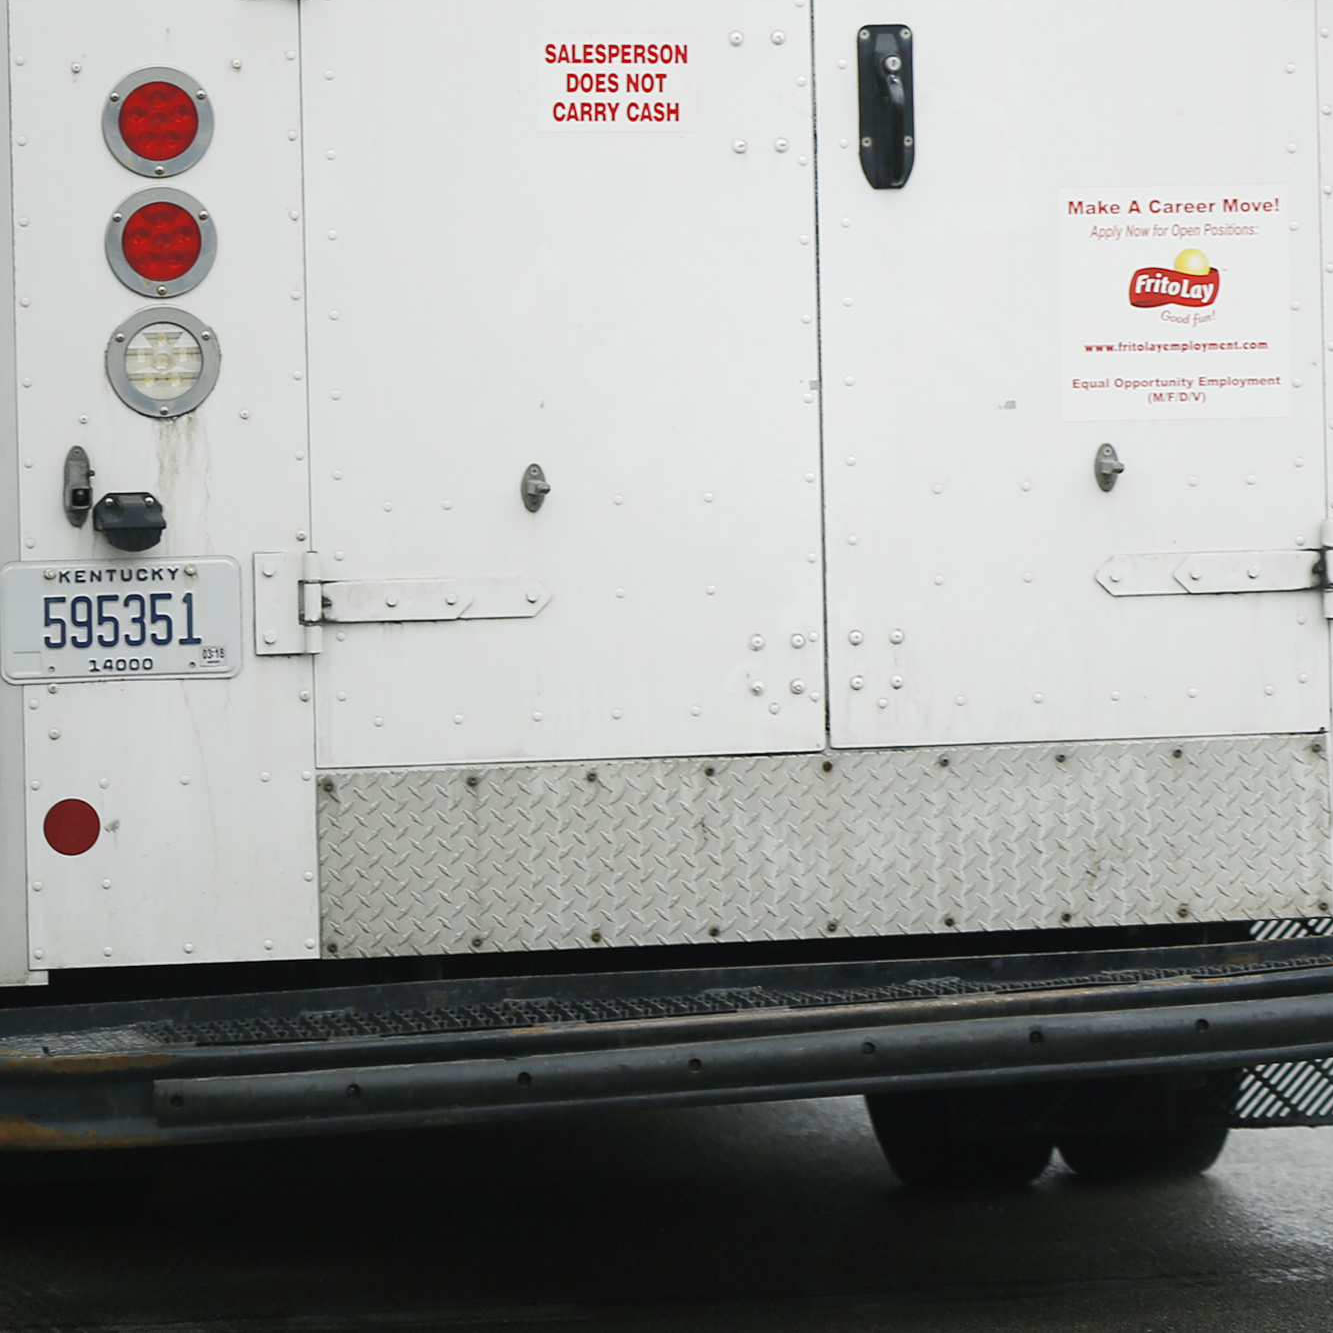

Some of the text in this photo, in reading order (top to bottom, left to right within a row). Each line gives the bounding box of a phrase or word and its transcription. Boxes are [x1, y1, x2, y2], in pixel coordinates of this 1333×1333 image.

[545, 44, 688, 64] SALESPERSON
[566, 73, 667, 93] DOES NOT
[552, 102, 680, 122] CARRY CASH
[1068, 198, 1280, 215] Make A Career Move!
[1090, 225, 1122, 240] Apply
[1125, 225, 1149, 237] Now
[1153, 224, 1168, 237] for
[1171, 224, 1200, 239] Open
[1160, 310, 1191, 325] Good
[1084, 341, 1269, 353] www.fritolayemployment.com
[1072, 376, 1282, 391] Equal Opportunity Employment
[59, 568, 180, 584] KENTUCKY
[43, 592, 202, 649] 595351
[88, 657, 154, 673] 14000
